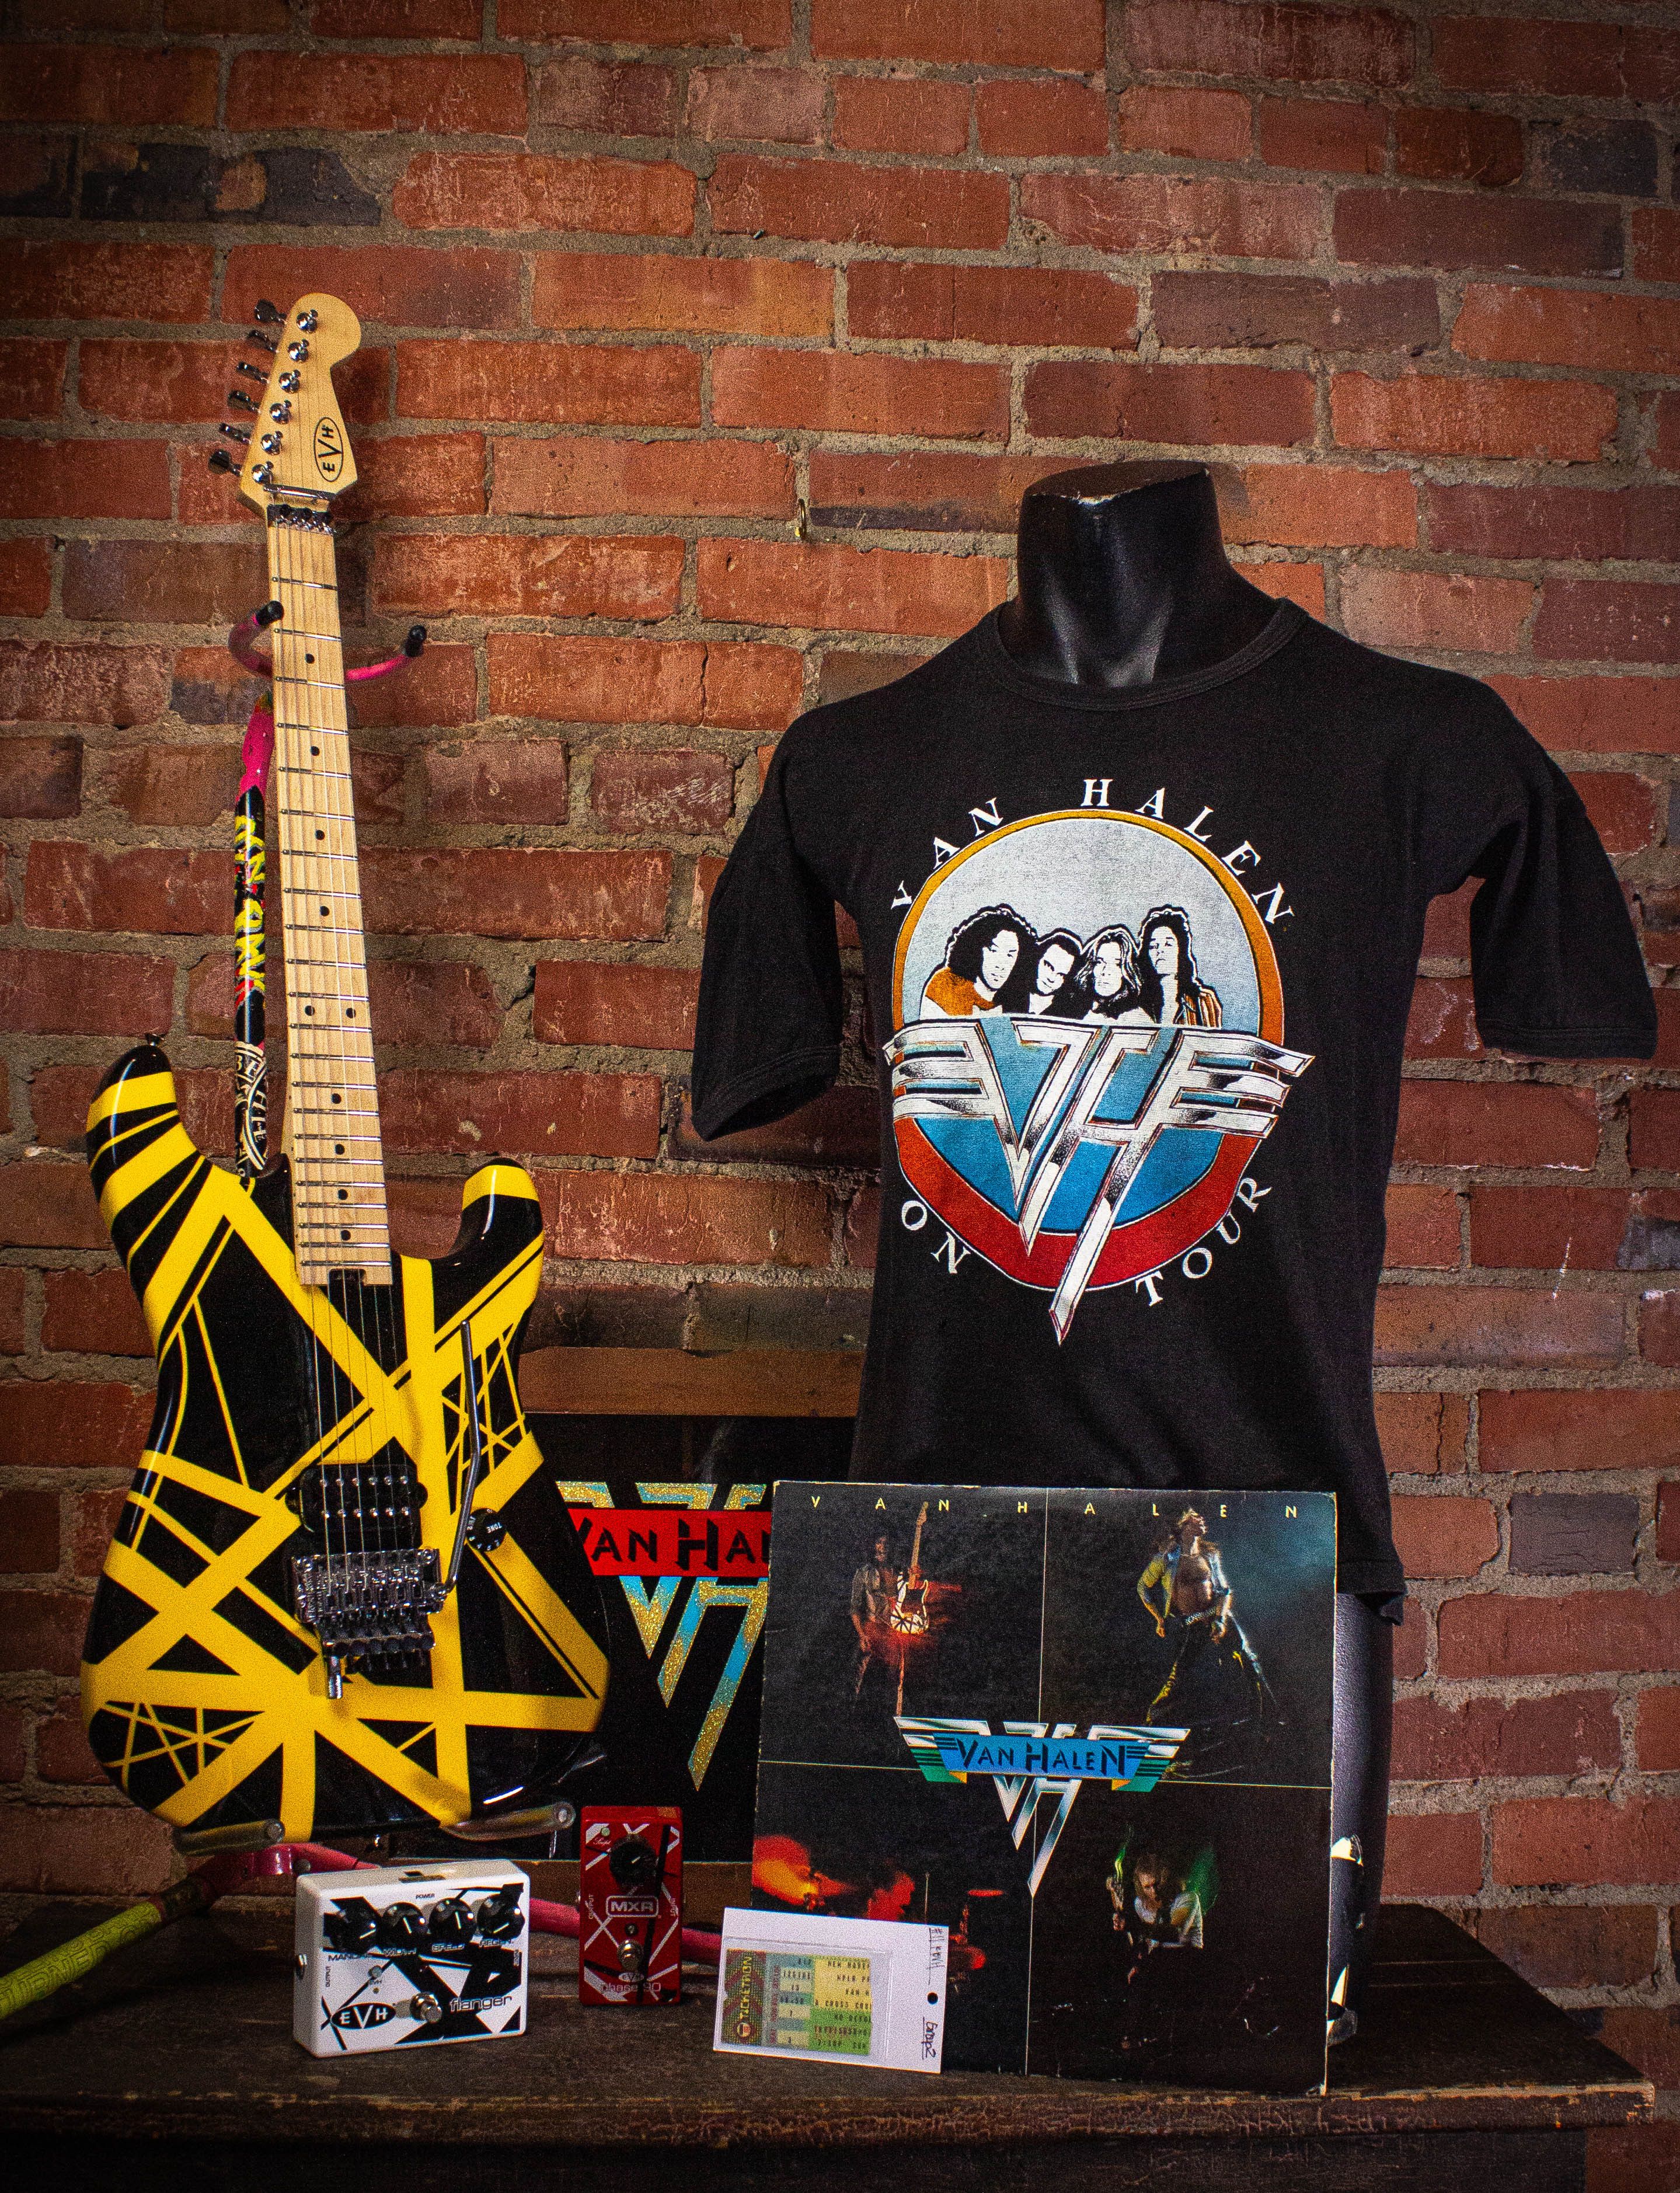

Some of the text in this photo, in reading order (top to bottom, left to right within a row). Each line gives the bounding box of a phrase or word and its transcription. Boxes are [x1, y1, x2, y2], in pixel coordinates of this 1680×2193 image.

[317, 424, 343, 473] EVH
[890, 778, 1294, 925] VAN HALEN
[901, 1176, 1272, 1308] ON TOUR
[811, 1495, 1298, 1519] VAN HALEN
[955, 1739, 1126, 1776] VAN HALEN
[611, 1901, 654, 1912] MXR
[449, 1994, 513, 2013] flanger
[739, 1955, 753, 2020] TICKETRON
[339, 2004, 388, 2030] EVH
